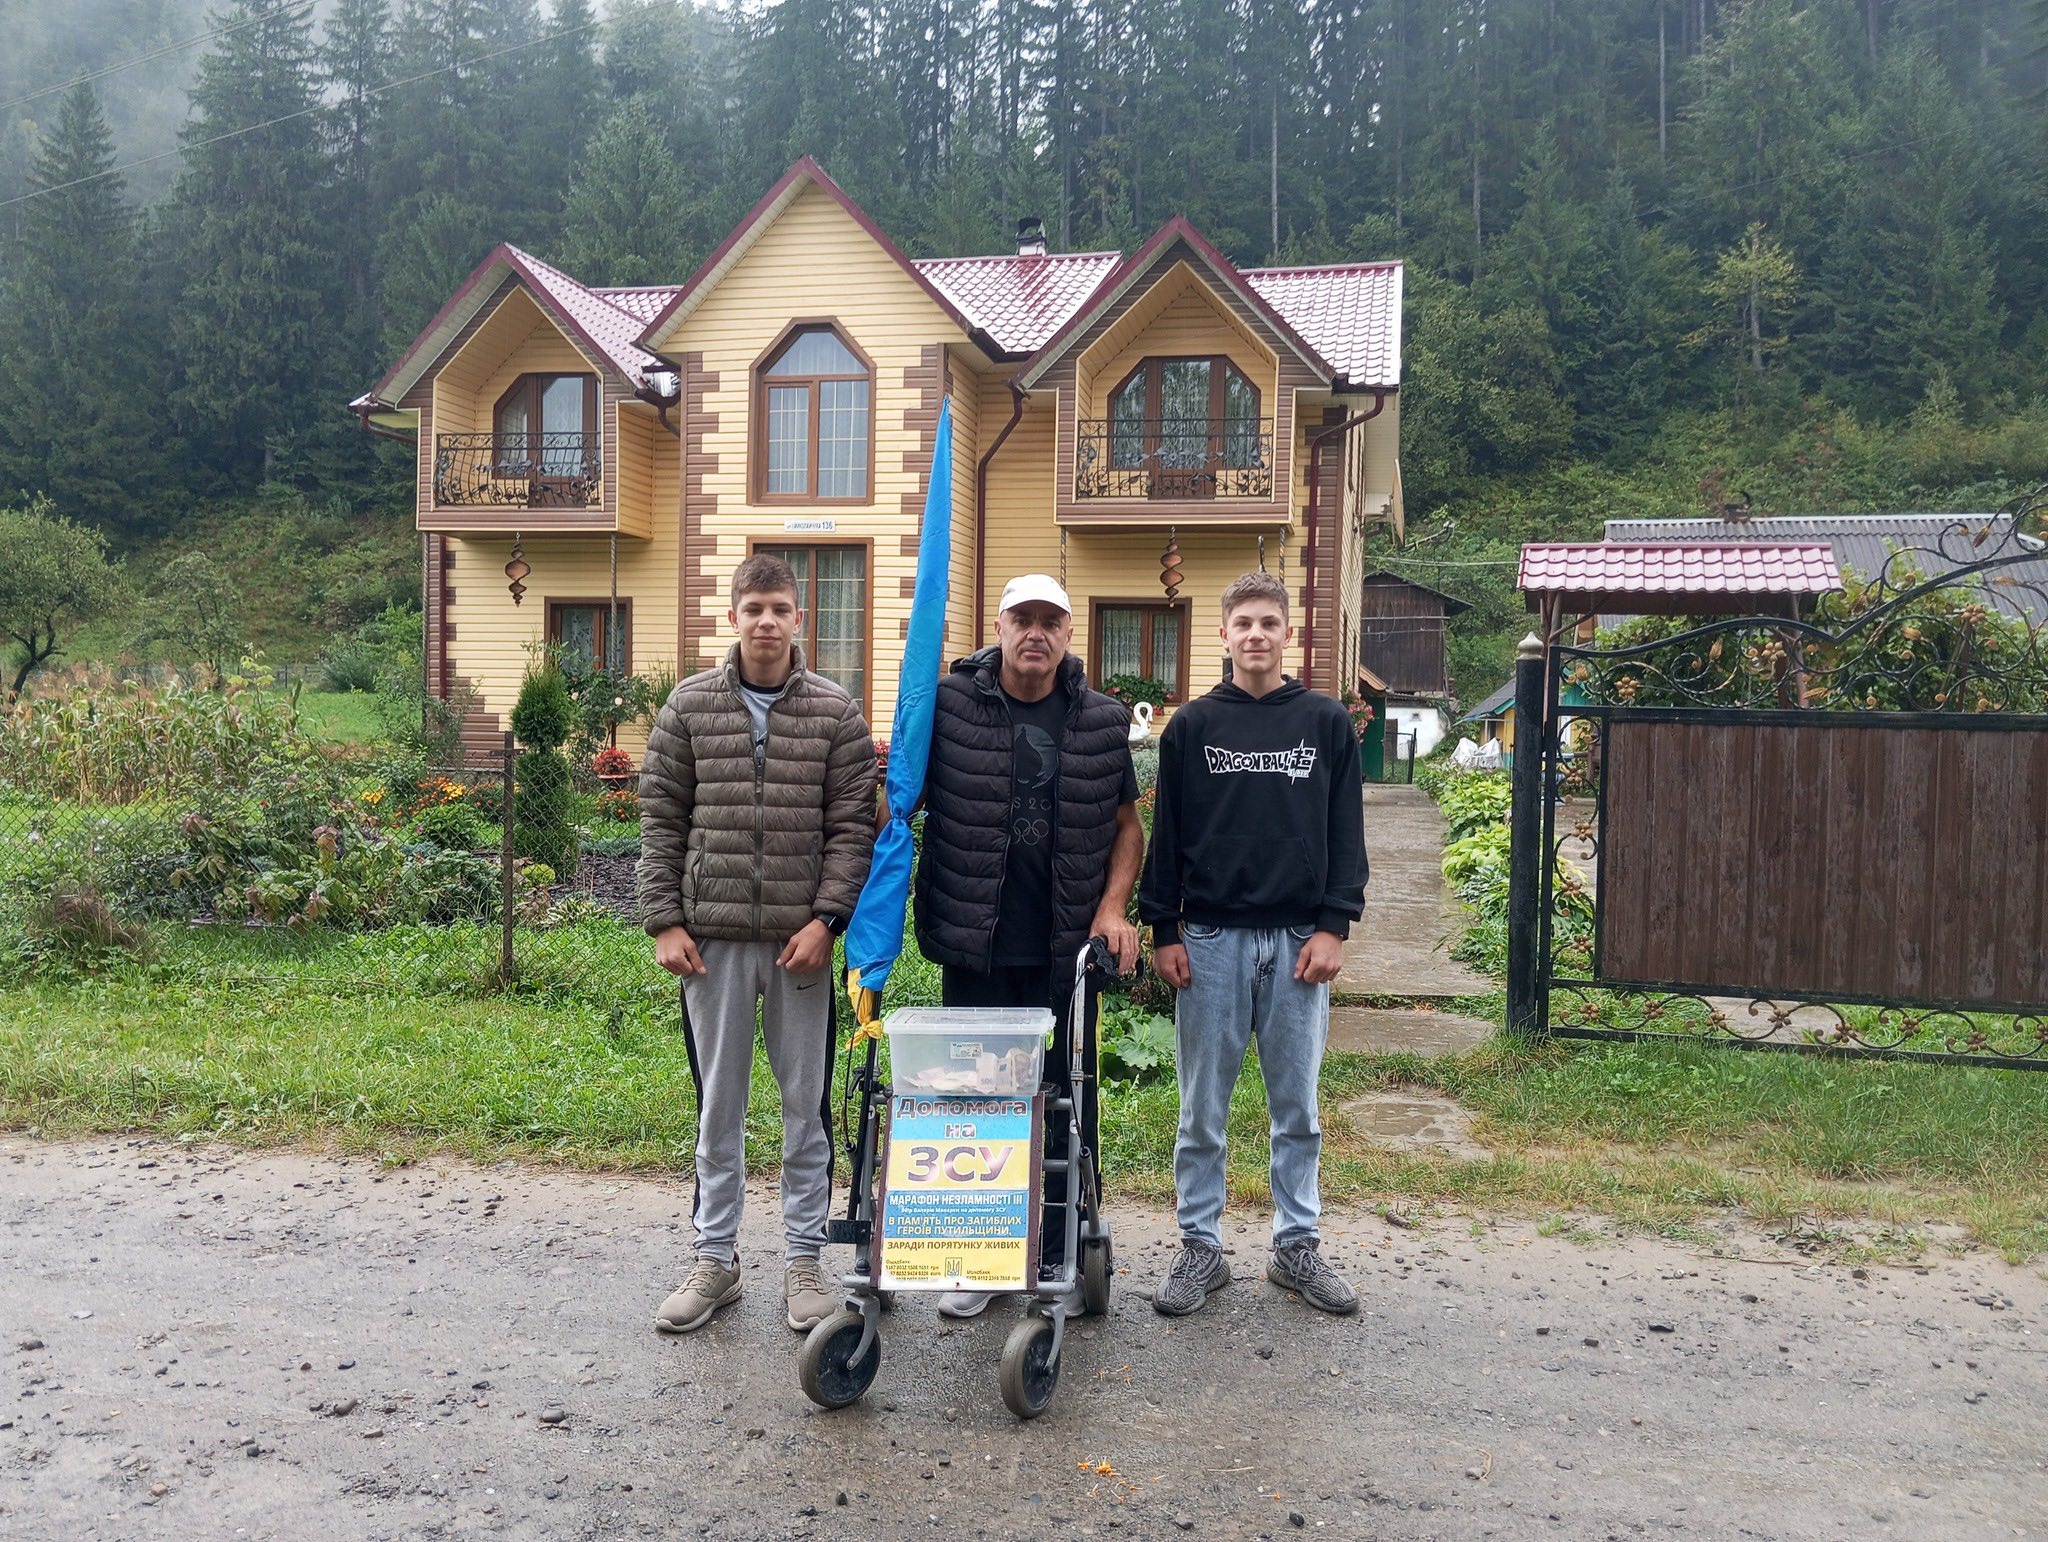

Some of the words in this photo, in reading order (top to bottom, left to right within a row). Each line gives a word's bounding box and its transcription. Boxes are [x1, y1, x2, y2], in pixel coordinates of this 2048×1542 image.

[896, 1097, 1027, 1119] Допомога
[945, 1122, 977, 1139] на
[907, 1145, 1014, 1182] ЗСУ
[889, 1194, 940, 1205] МАРАФОН
[941, 1194, 1011, 1205] НЕЗЛАМНОСТІ
[888, 1216, 895, 1225] В
[944, 1216, 965, 1225] ПРО
[967, 1216, 1022, 1225] ЗАГИБЛИХ
[897, 1225, 932, 1235] ГЕРОЇВ
[887, 1241, 924, 1250] ЗАРАДИ
[927, 1241, 982, 1250] ПОРЯТУНКУ
[984, 1241, 1020, 1250] ЖИВИХ
